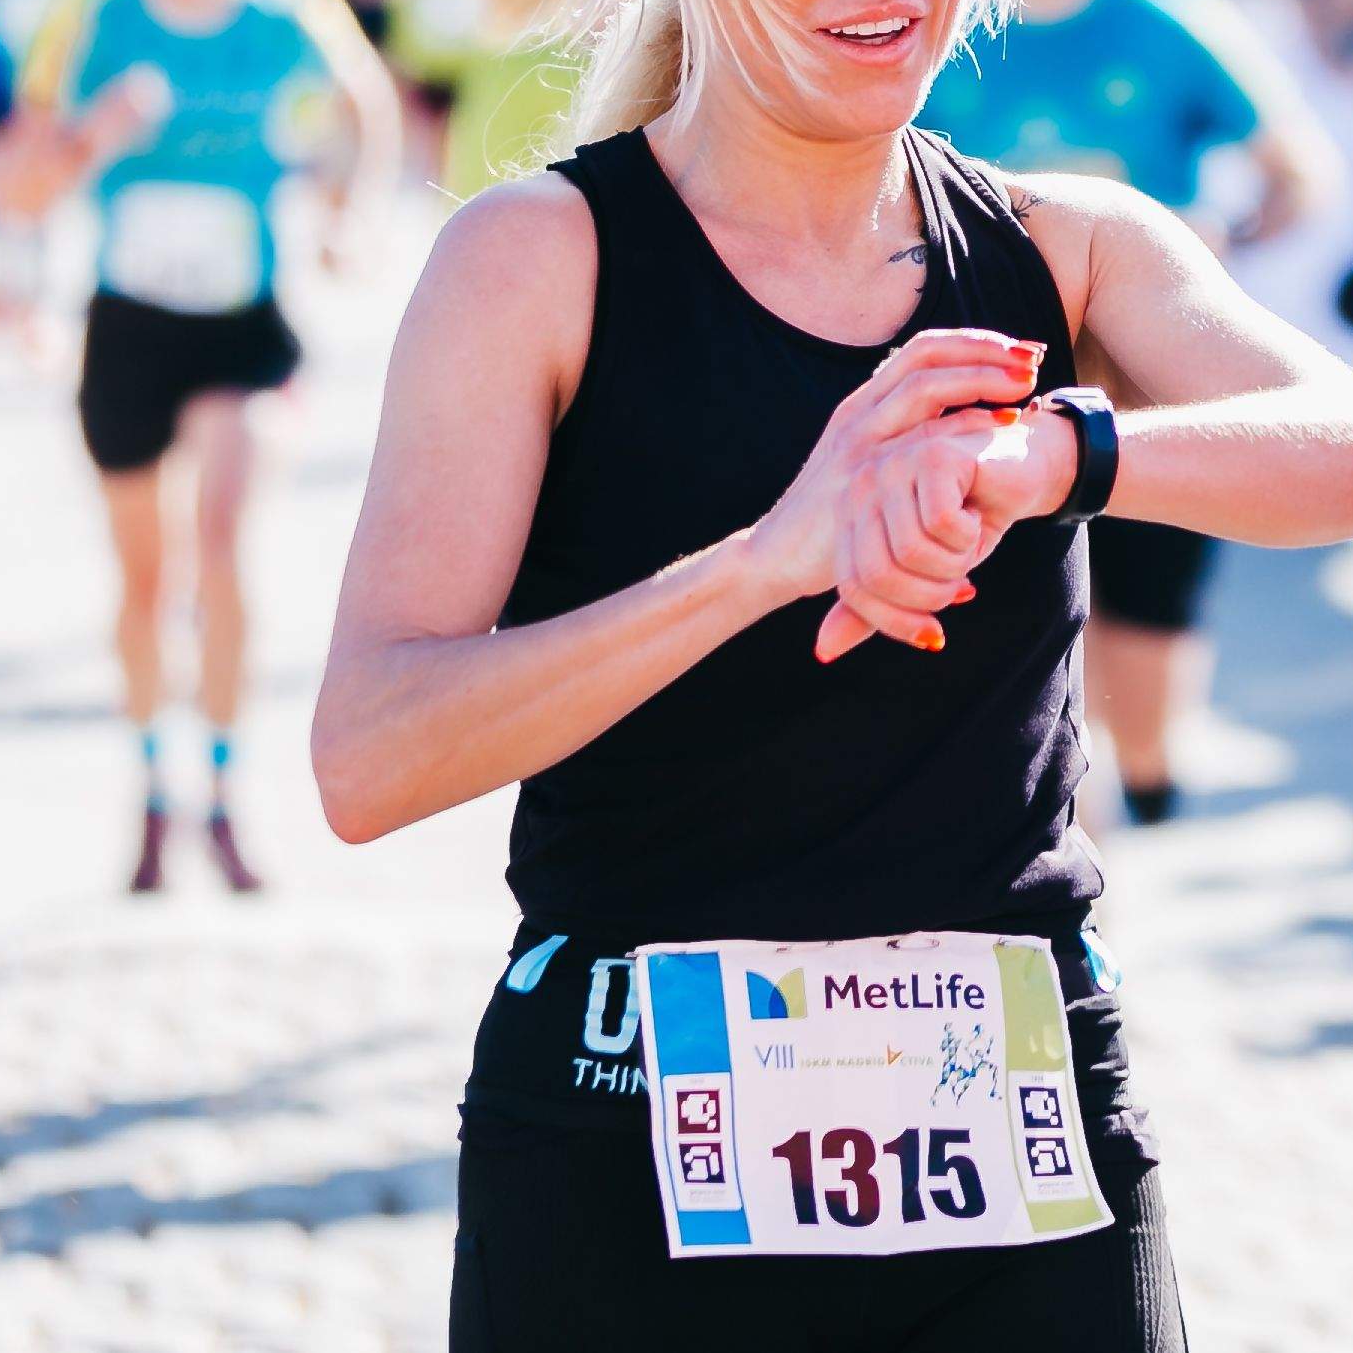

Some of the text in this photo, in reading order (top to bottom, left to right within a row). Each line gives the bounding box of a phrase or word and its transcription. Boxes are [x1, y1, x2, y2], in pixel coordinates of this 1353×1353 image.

[823, 972, 986, 1010] MetLife
[754, 1043, 795, 1070] VIII
[772, 1126, 988, 1228] 1315
